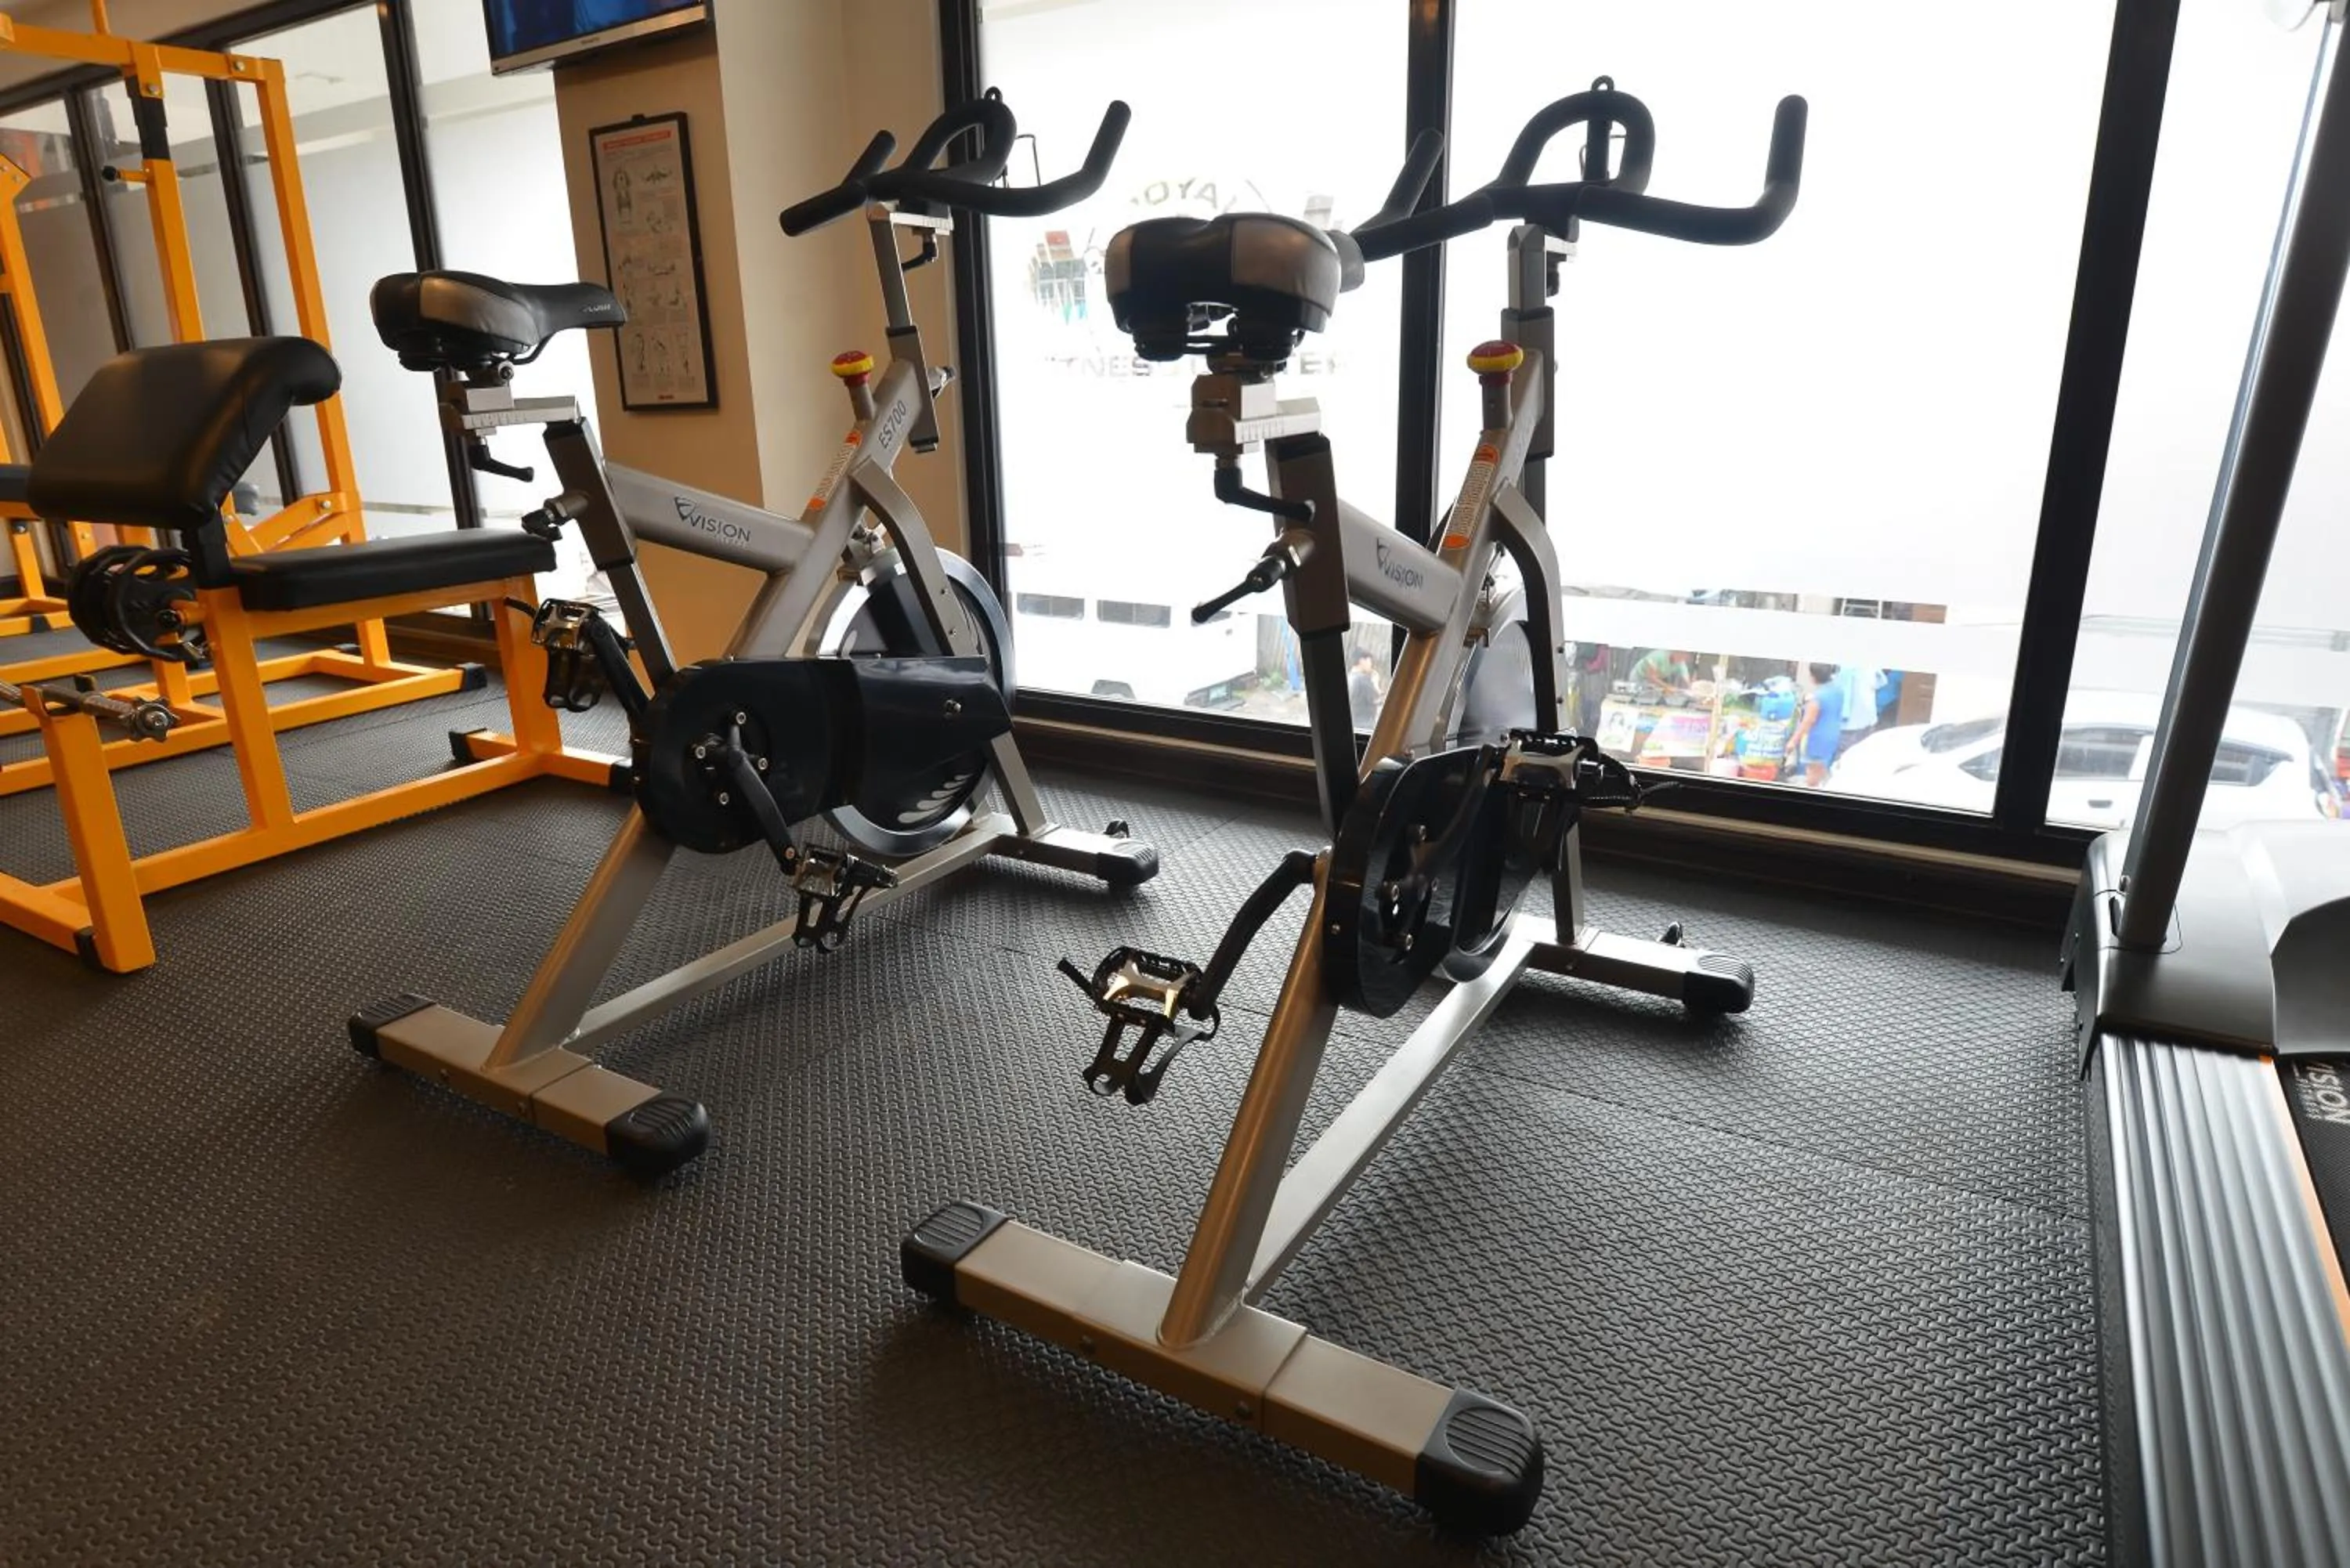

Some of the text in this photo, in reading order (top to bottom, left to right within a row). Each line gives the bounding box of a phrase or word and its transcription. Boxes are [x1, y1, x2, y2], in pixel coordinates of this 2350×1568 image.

[878, 399, 906, 449] ES700
[690, 515, 751, 542] VISION
[1383, 558, 1424, 590] VISION
